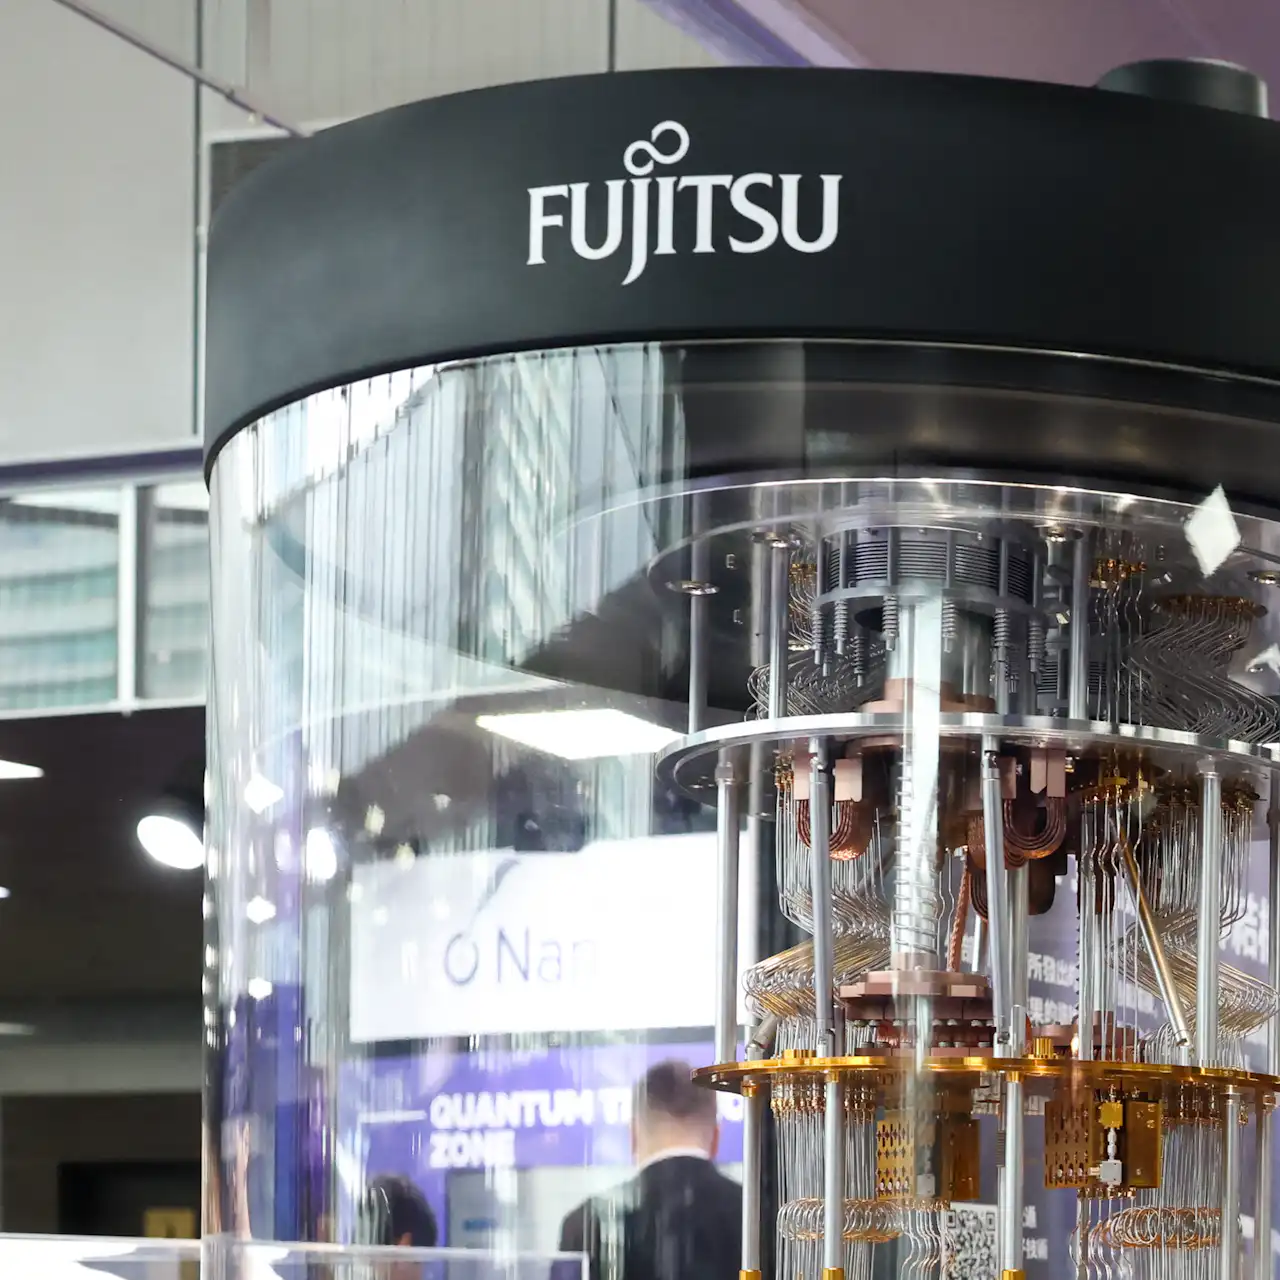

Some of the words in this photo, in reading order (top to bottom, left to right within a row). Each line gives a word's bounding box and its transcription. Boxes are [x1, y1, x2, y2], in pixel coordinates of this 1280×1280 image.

[526, 120, 843, 285] FUJITSU
[429, 1087, 595, 1130] QUANTUM
[429, 1129, 517, 1168] ZONE
